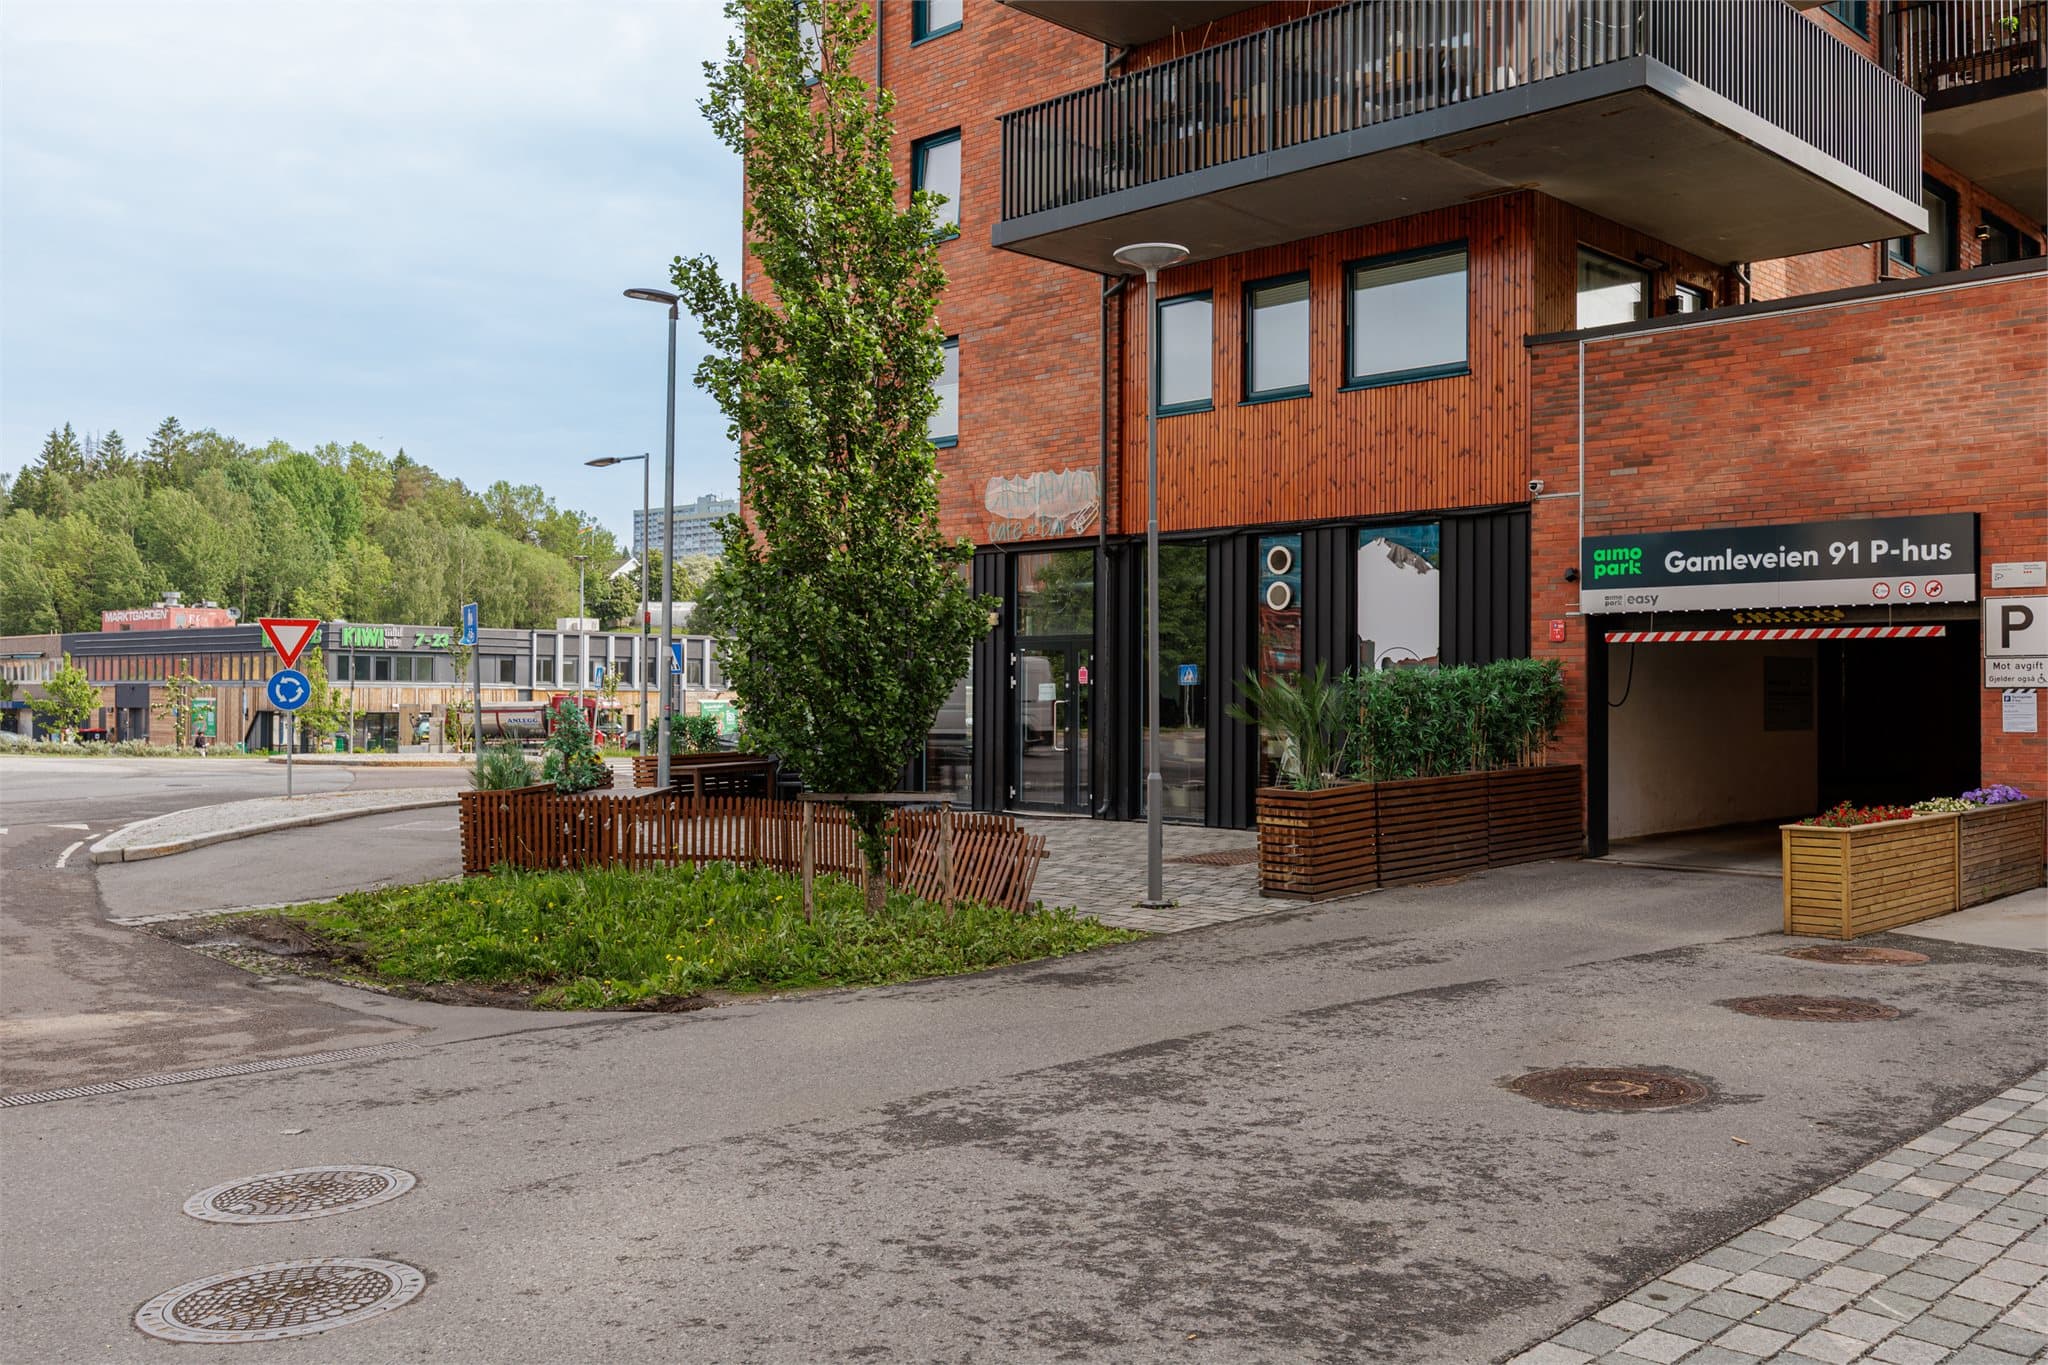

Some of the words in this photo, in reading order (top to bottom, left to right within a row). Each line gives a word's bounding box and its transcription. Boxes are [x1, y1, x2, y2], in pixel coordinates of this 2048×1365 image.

[1593, 547, 1642, 562] aimo
[1664, 545, 1819, 574] Gamleveien
[1828, 541, 1859, 566] 91
[1870, 538, 1953, 563] P-hus
[1593, 560, 1642, 580] park
[1903, 585, 1911, 595] 5
[1627, 594, 1659, 606] easy
[104, 608, 168, 622] MARKTGARDEN
[2001, 605, 2034, 649] P
[342, 627, 385, 648] KIWI
[1993, 662, 2011, 670] Mot
[2015, 661, 2044, 671] avgift
[1988, 676, 2015, 684] Gjelder
